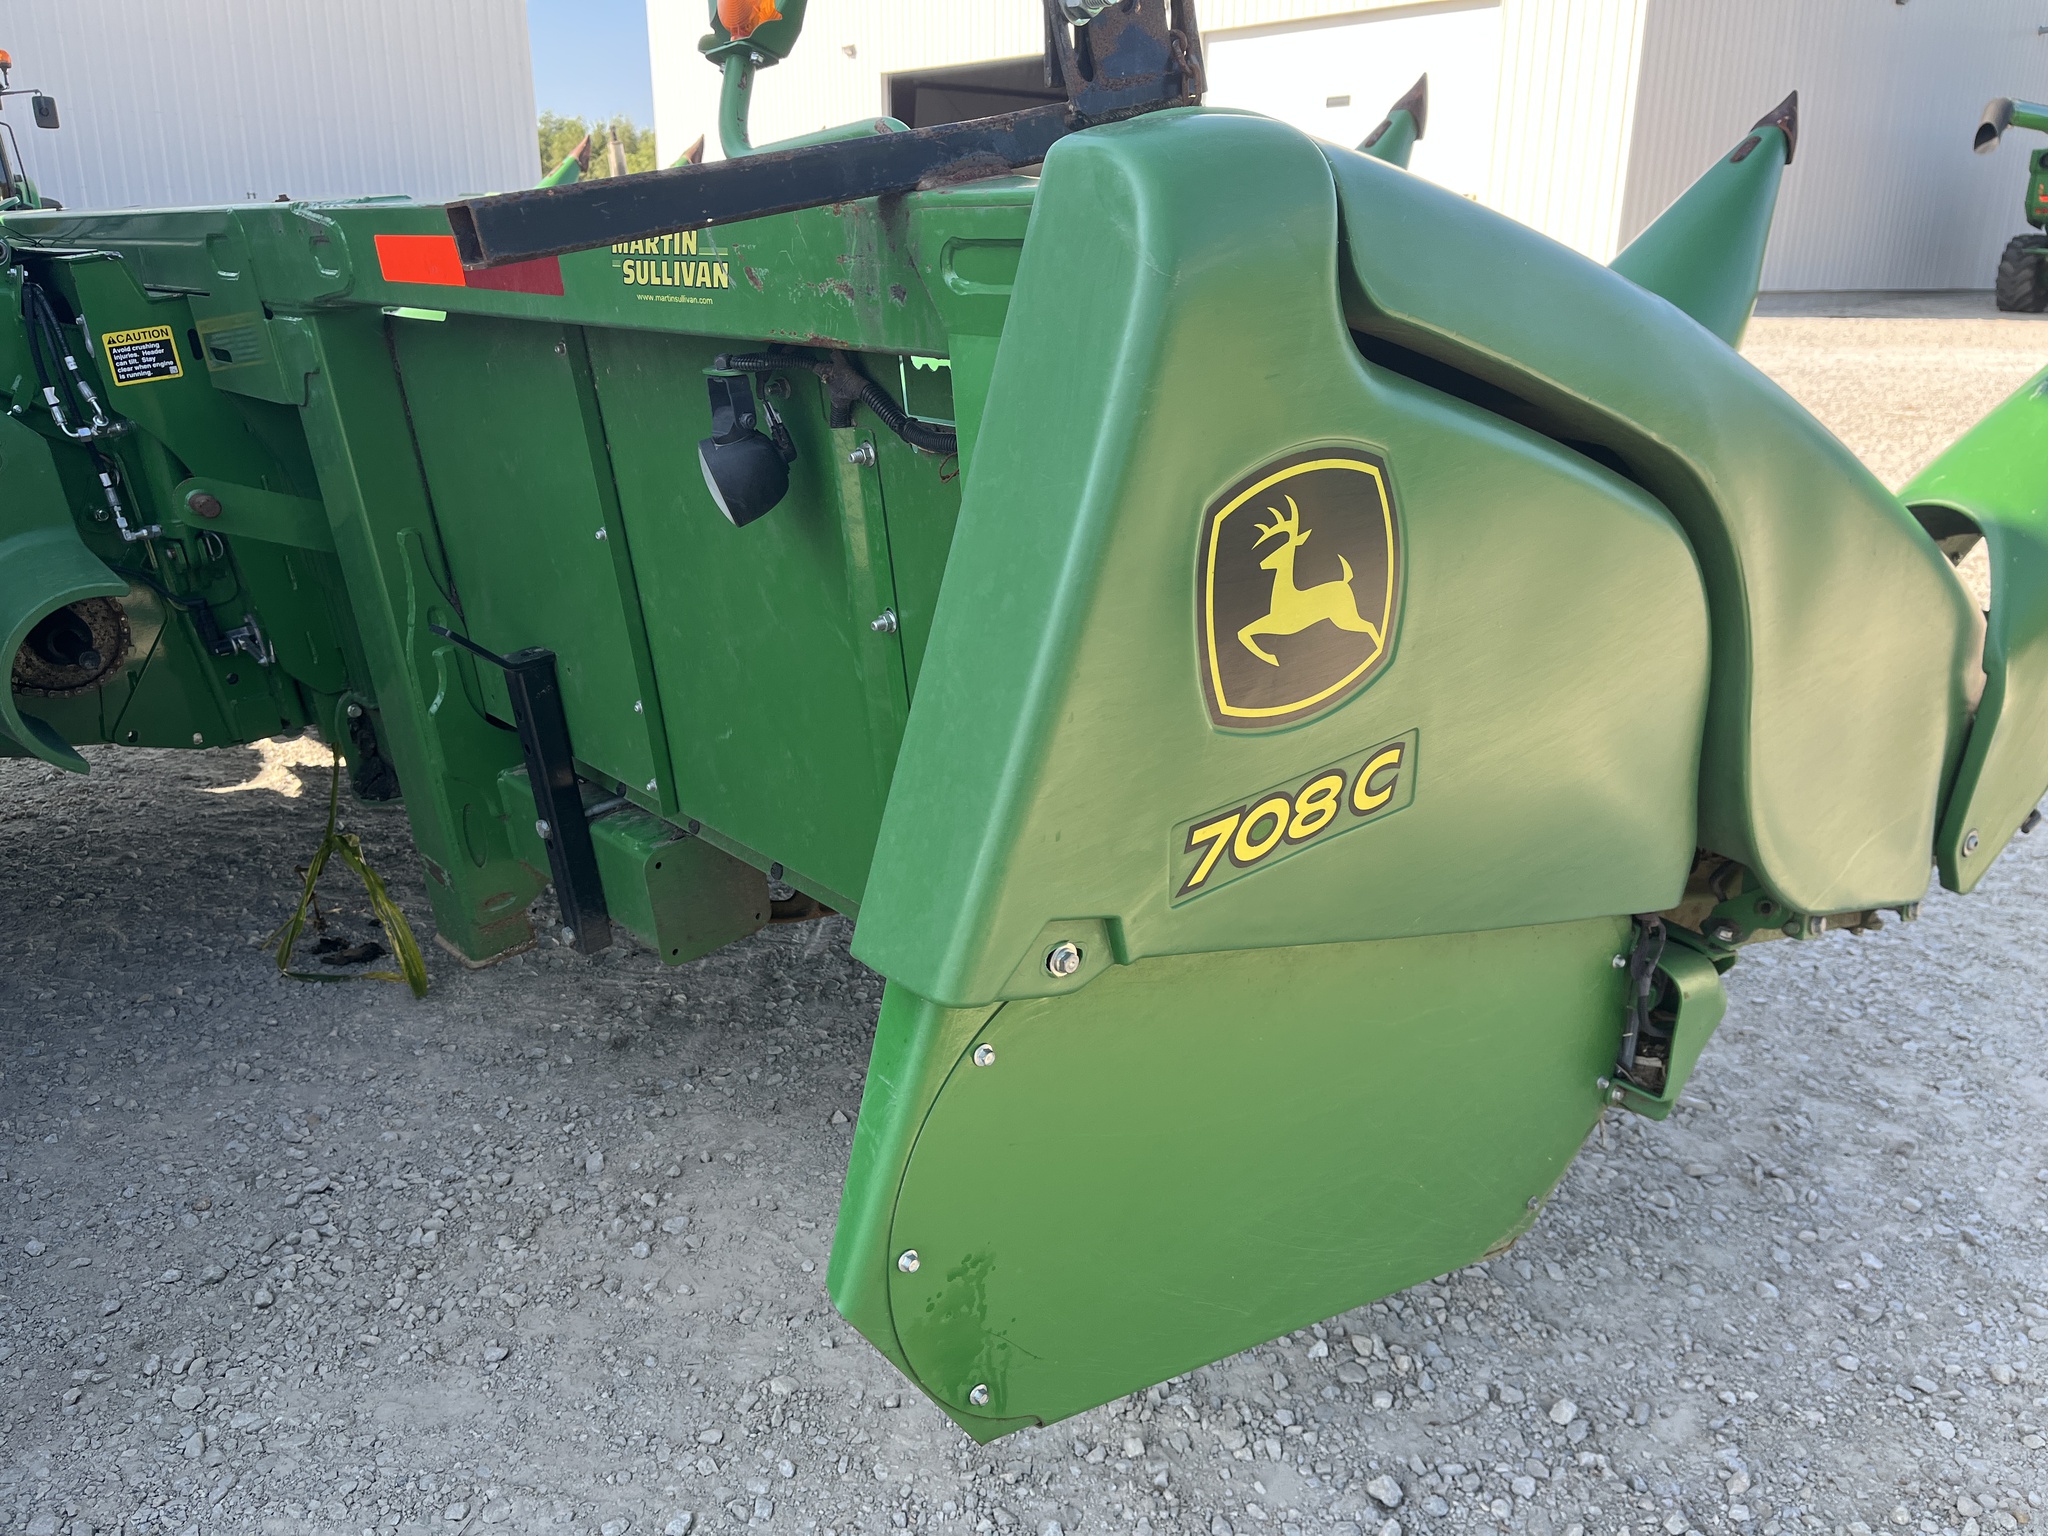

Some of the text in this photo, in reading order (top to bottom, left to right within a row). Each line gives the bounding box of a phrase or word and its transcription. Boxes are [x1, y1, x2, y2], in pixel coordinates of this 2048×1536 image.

[622, 259, 729, 289] SULLIVAN
[636, 293, 713, 305] www.martinsullivan.com
[116, 328, 169, 343] CAUTION
[112, 342, 160, 354] Avoid crushing
[114, 347, 164, 360] injuries. Header
[141, 355, 156, 363] Stay
[152, 360, 174, 369] engine
[127, 370, 153, 379] running.
[1176, 742, 1406, 898] 708 C
